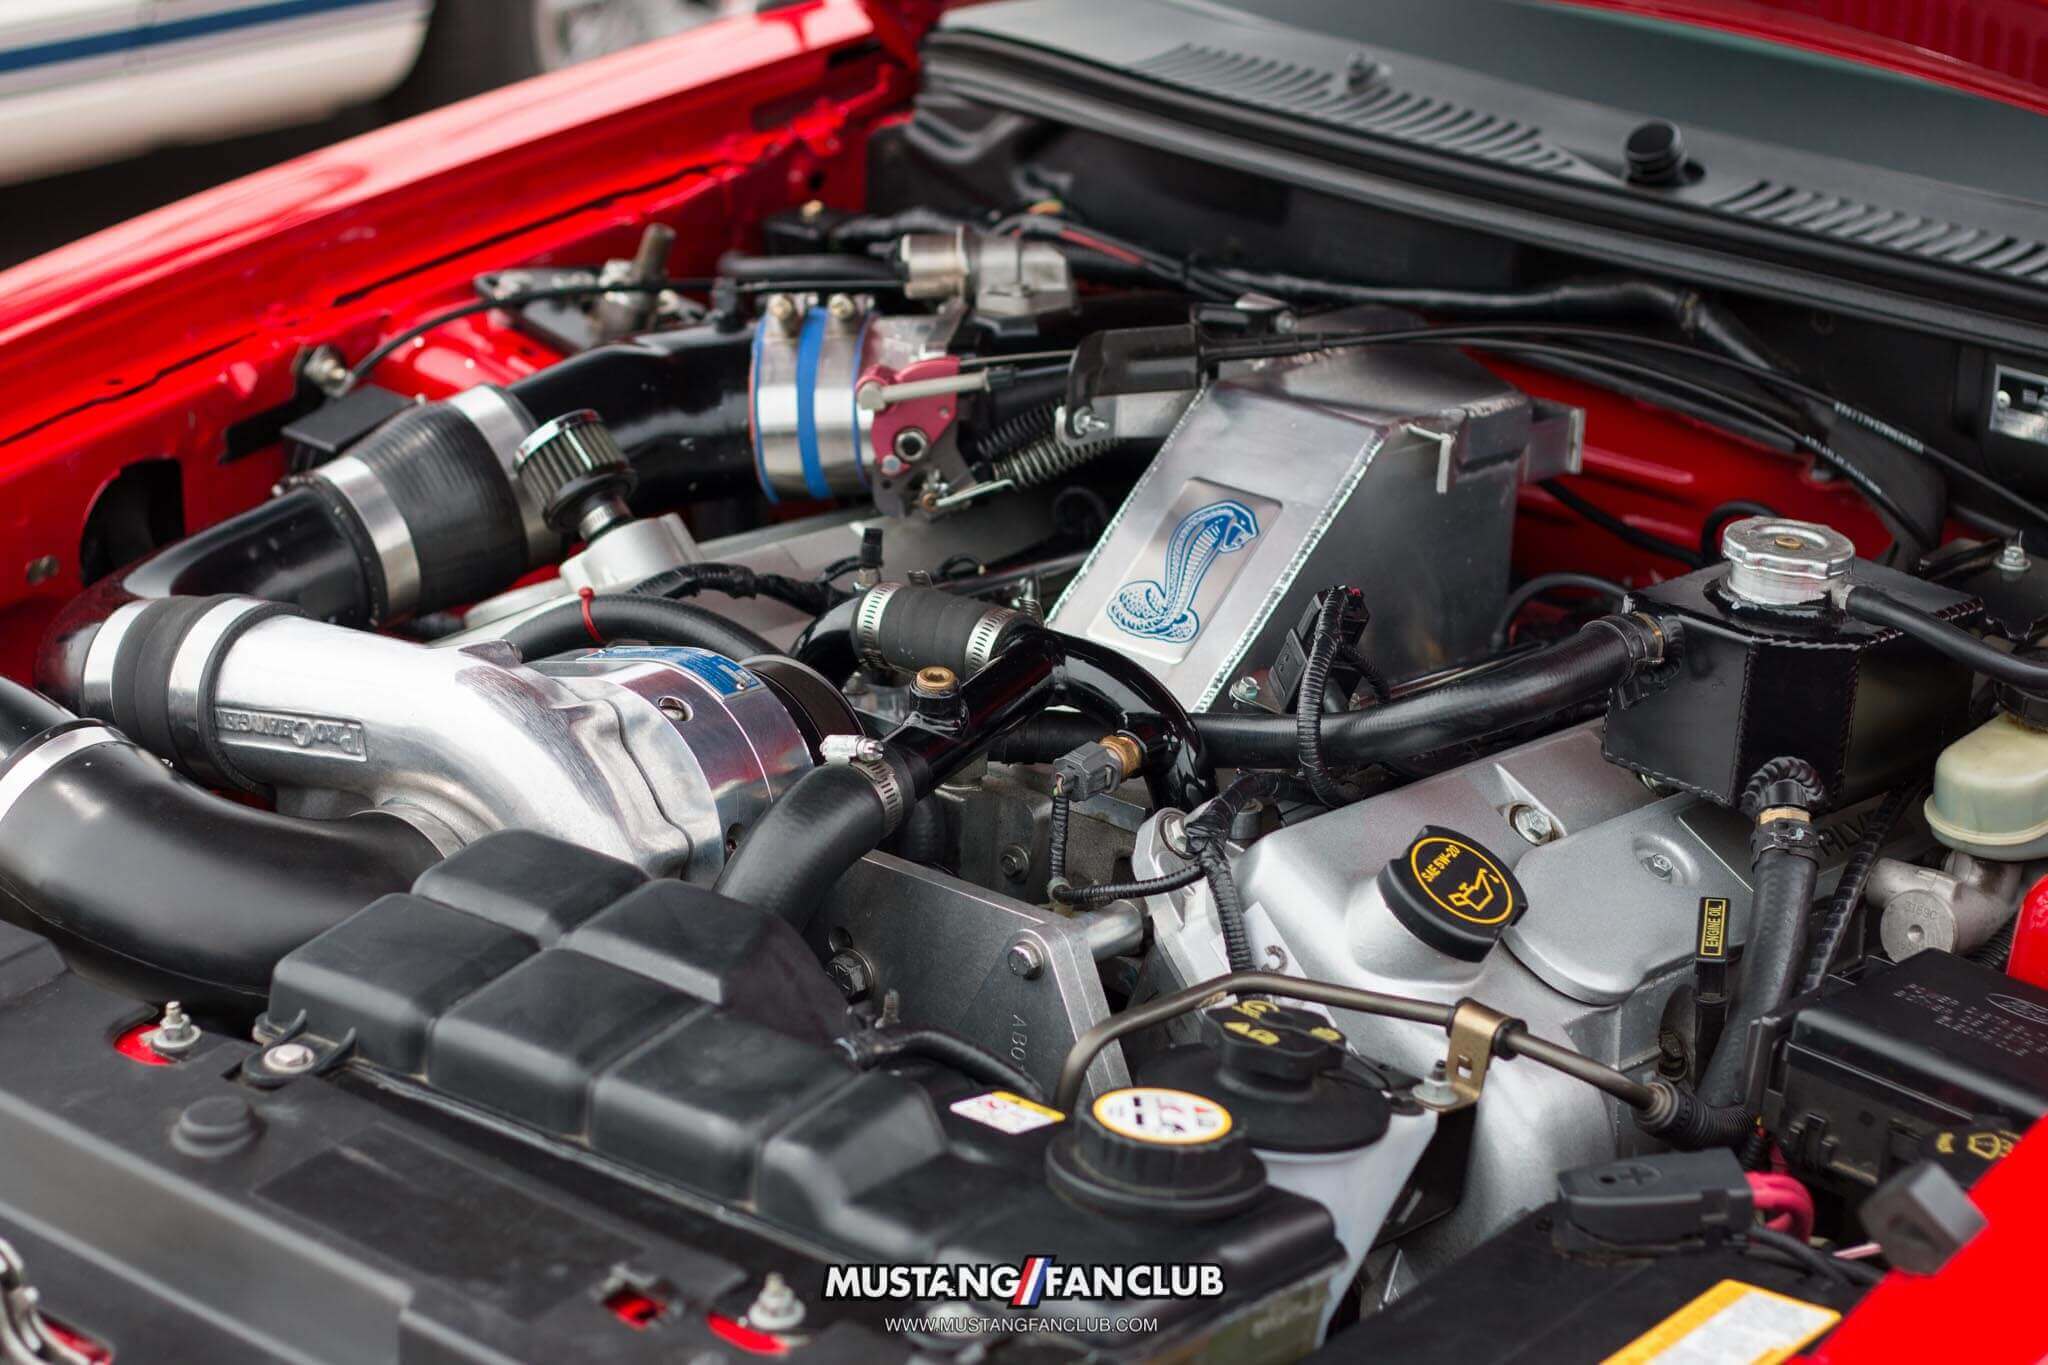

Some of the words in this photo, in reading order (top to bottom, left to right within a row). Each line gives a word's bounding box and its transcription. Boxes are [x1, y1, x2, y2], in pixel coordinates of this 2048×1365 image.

[1420, 861, 1441, 883] SAE
[1434, 844, 1462, 870] 5W-20
[1709, 905, 1722, 917] OIL
[1705, 917, 1721, 947] ENGINE
